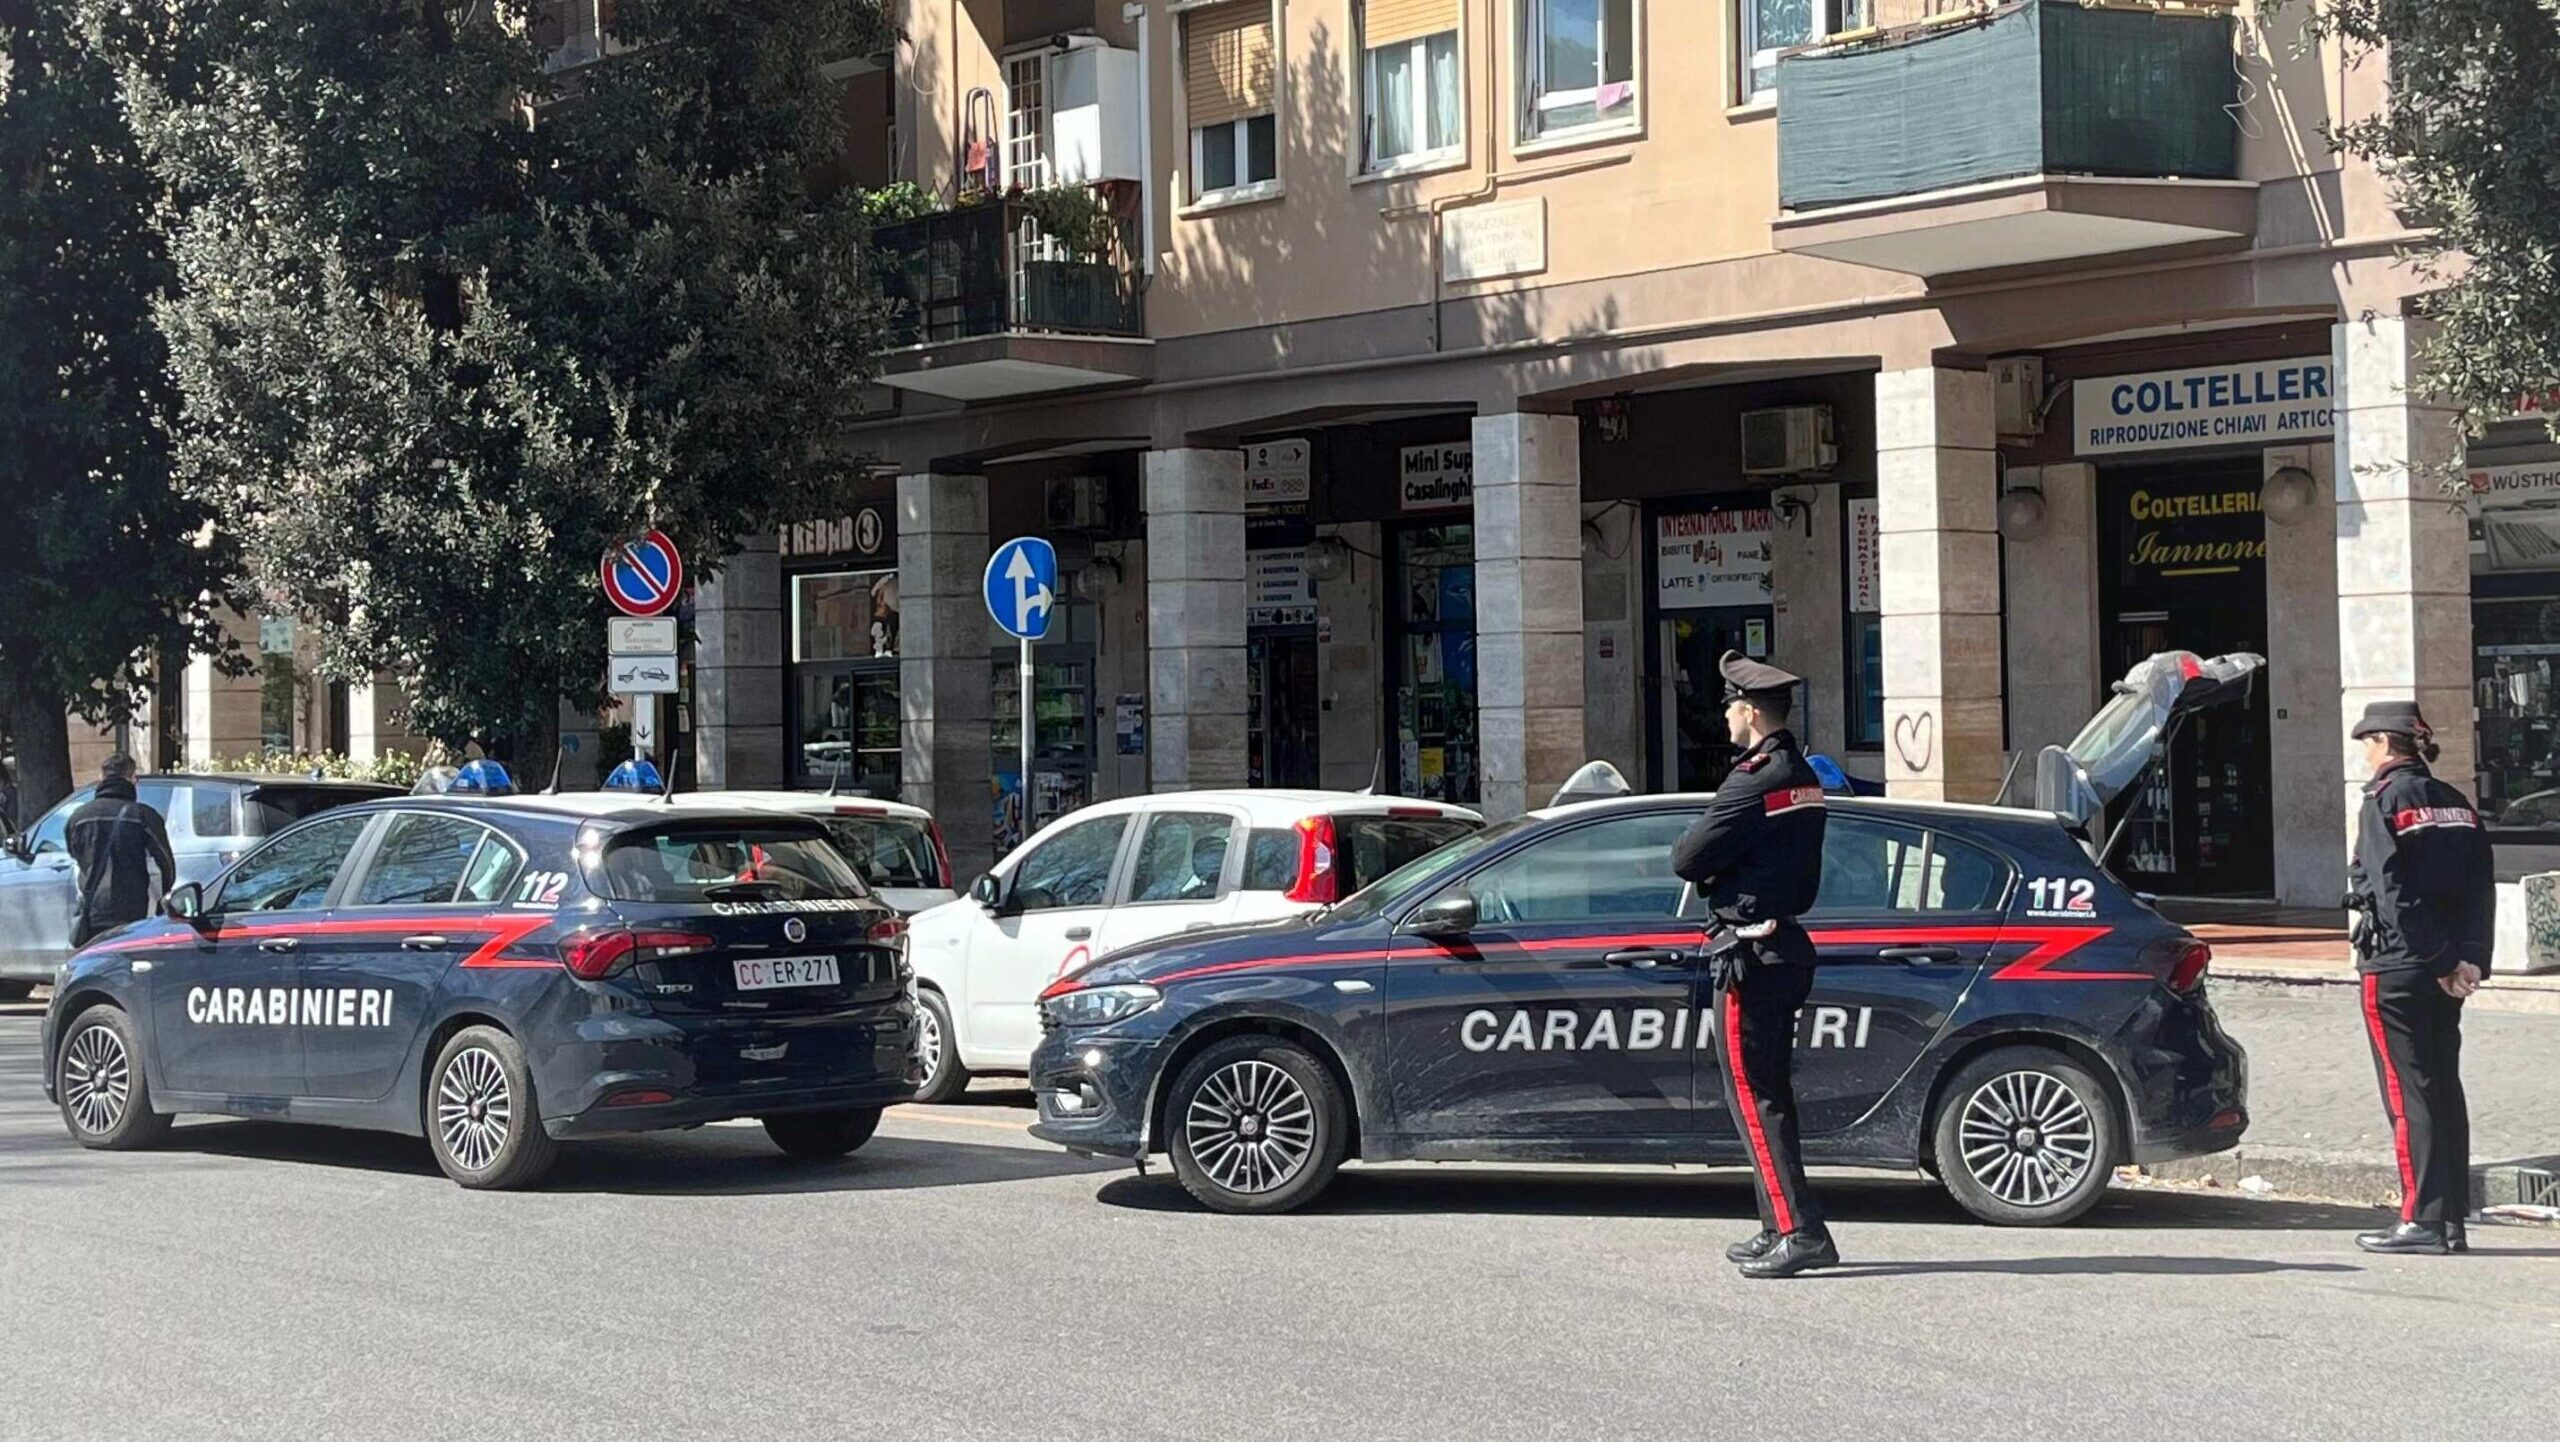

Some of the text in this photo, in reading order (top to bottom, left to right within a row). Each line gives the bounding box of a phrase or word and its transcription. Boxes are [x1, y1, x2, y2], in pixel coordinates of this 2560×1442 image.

[2090, 419, 2208, 446] RIPRODUZIONE
[2214, 414, 2267, 436] CHIAVI
[1405, 448, 1439, 474] Mini
[862, 513, 876, 548] 3
[1660, 512, 1738, 537] INTERNATIONAL
[1661, 543, 1761, 560] BIBITE PANE
[2128, 531, 2267, 566] Iannone
[1661, 576, 1695, 589] LATTE
[518, 870, 569, 902] 112
[2028, 877, 2095, 910] 112
[738, 958, 835, 986] CC ER 271
[656, 983, 693, 994] TIPO
[187, 986, 394, 1027] CARABINIERI
[1461, 1006, 1873, 1052] CARABIRI
